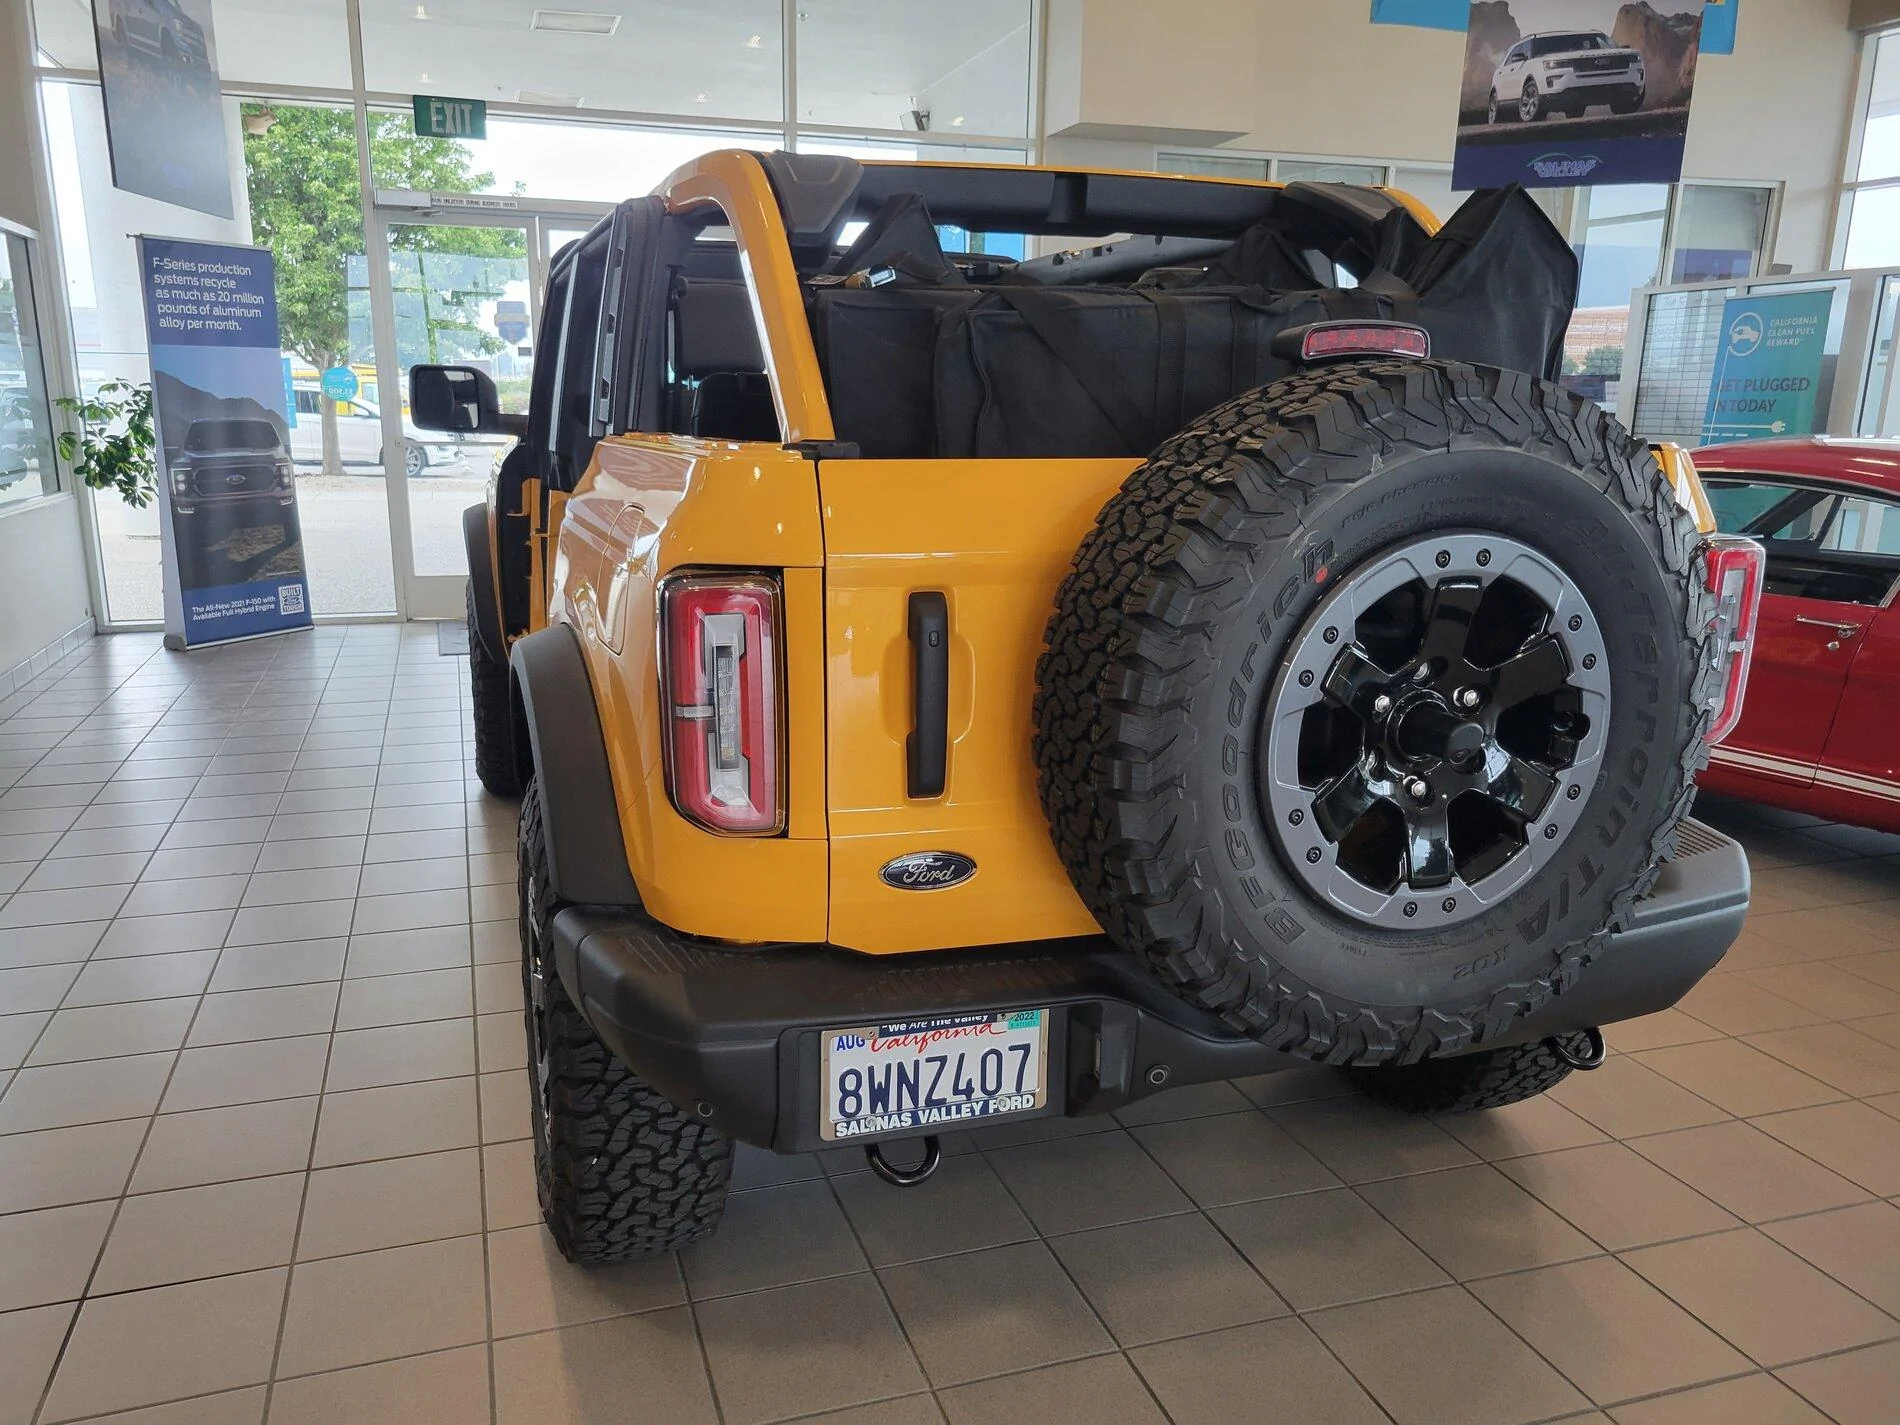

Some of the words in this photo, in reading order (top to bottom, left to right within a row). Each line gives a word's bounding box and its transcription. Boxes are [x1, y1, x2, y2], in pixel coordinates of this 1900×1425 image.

[430, 101, 473, 135] EXIT
[153, 257, 196, 272] F-Series
[198, 262, 251, 276] production
[154, 274, 199, 286] systems
[201, 277, 236, 290] recycle
[156, 289, 170, 299] as
[172, 288, 200, 301] much
[203, 291, 216, 302] as
[218, 291, 230, 302] 20
[233, 293, 264, 305] million
[158, 303, 198, 315] pounds
[200, 303, 211, 315] of
[213, 306, 262, 318] aluminum
[160, 316, 185, 330] alloy
[188, 319, 203, 331] per
[206, 319, 242, 331] month.
[1770, 316, 1818, 327] CALIFORNIA
[1768, 328, 1794, 337] CLEAN
[1795, 326, 1816, 336] FUEL
[1716, 379, 1742, 392] GET
[1744, 377, 1810, 392] PLUGGED
[1729, 399, 1777, 413] TODAY
[281, 587, 302, 597] BUILT
[192, 605, 204, 614] The
[205, 602, 230, 612] All-New
[231, 600, 245, 609] 2021
[246, 598, 262, 608] F-150
[262, 596, 276, 605] with
[193, 610, 221, 621] Available
[222, 608, 234, 617] Full
[235, 605, 254, 616] Hybrid
[255, 603, 275, 614] Engine
[283, 604, 303, 612] TOUGH
[1222, 537, 1338, 946] BFGoodrich
[909, 1020, 928, 1030] Are
[931, 1018, 952, 1028] The
[954, 1014, 989, 1025] Valley
[836, 1034, 866, 1052] AUG
[870, 1022, 1008, 1055] California
[1013, 1011, 1036, 1022] 2022
[838, 1043, 1032, 1119] 8WNZ407
[917, 1100, 989, 1126] VALLEY
[989, 1094, 1035, 1115] FORD
